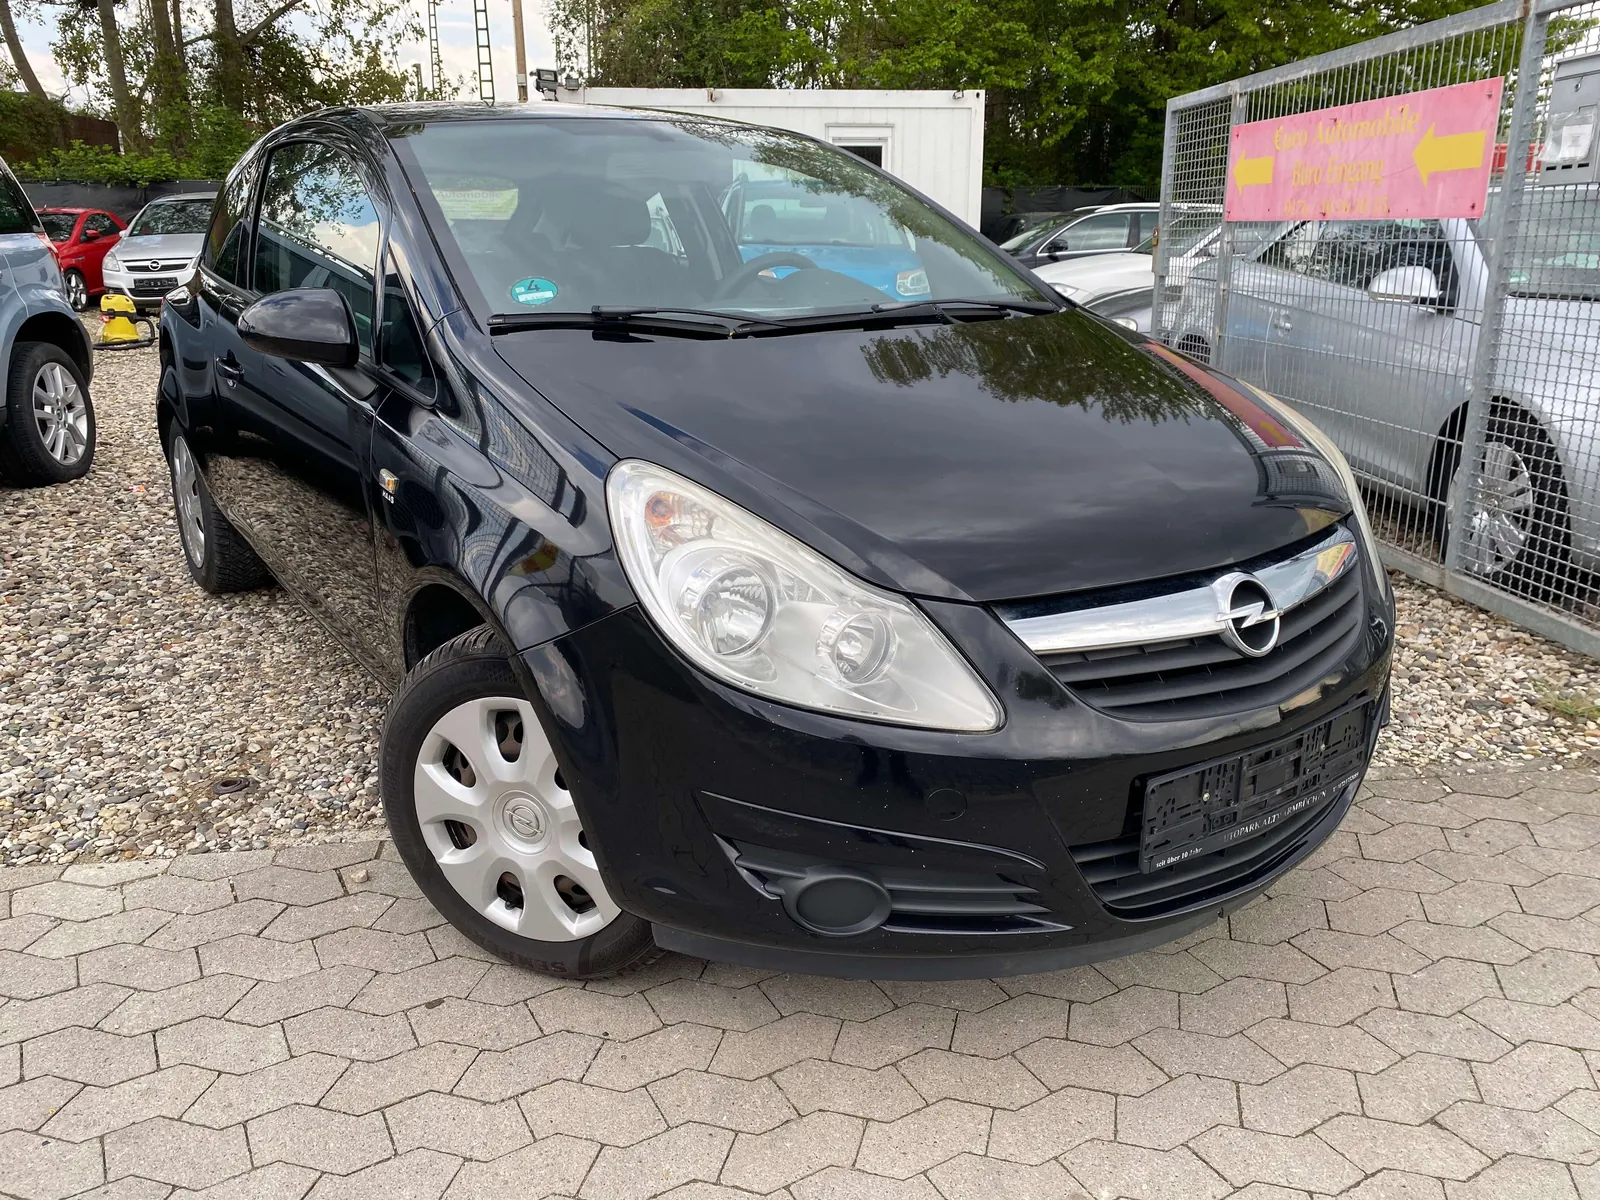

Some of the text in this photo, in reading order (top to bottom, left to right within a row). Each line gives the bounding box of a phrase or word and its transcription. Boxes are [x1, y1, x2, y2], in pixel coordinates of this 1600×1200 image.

[1313, 103, 1421, 146] Automobile
[1291, 155, 1385, 190] Büro Eingang
[527, 279, 541, 292] 4
[1156, 859, 1166, 868] seit
[1167, 855, 1181, 864] über
